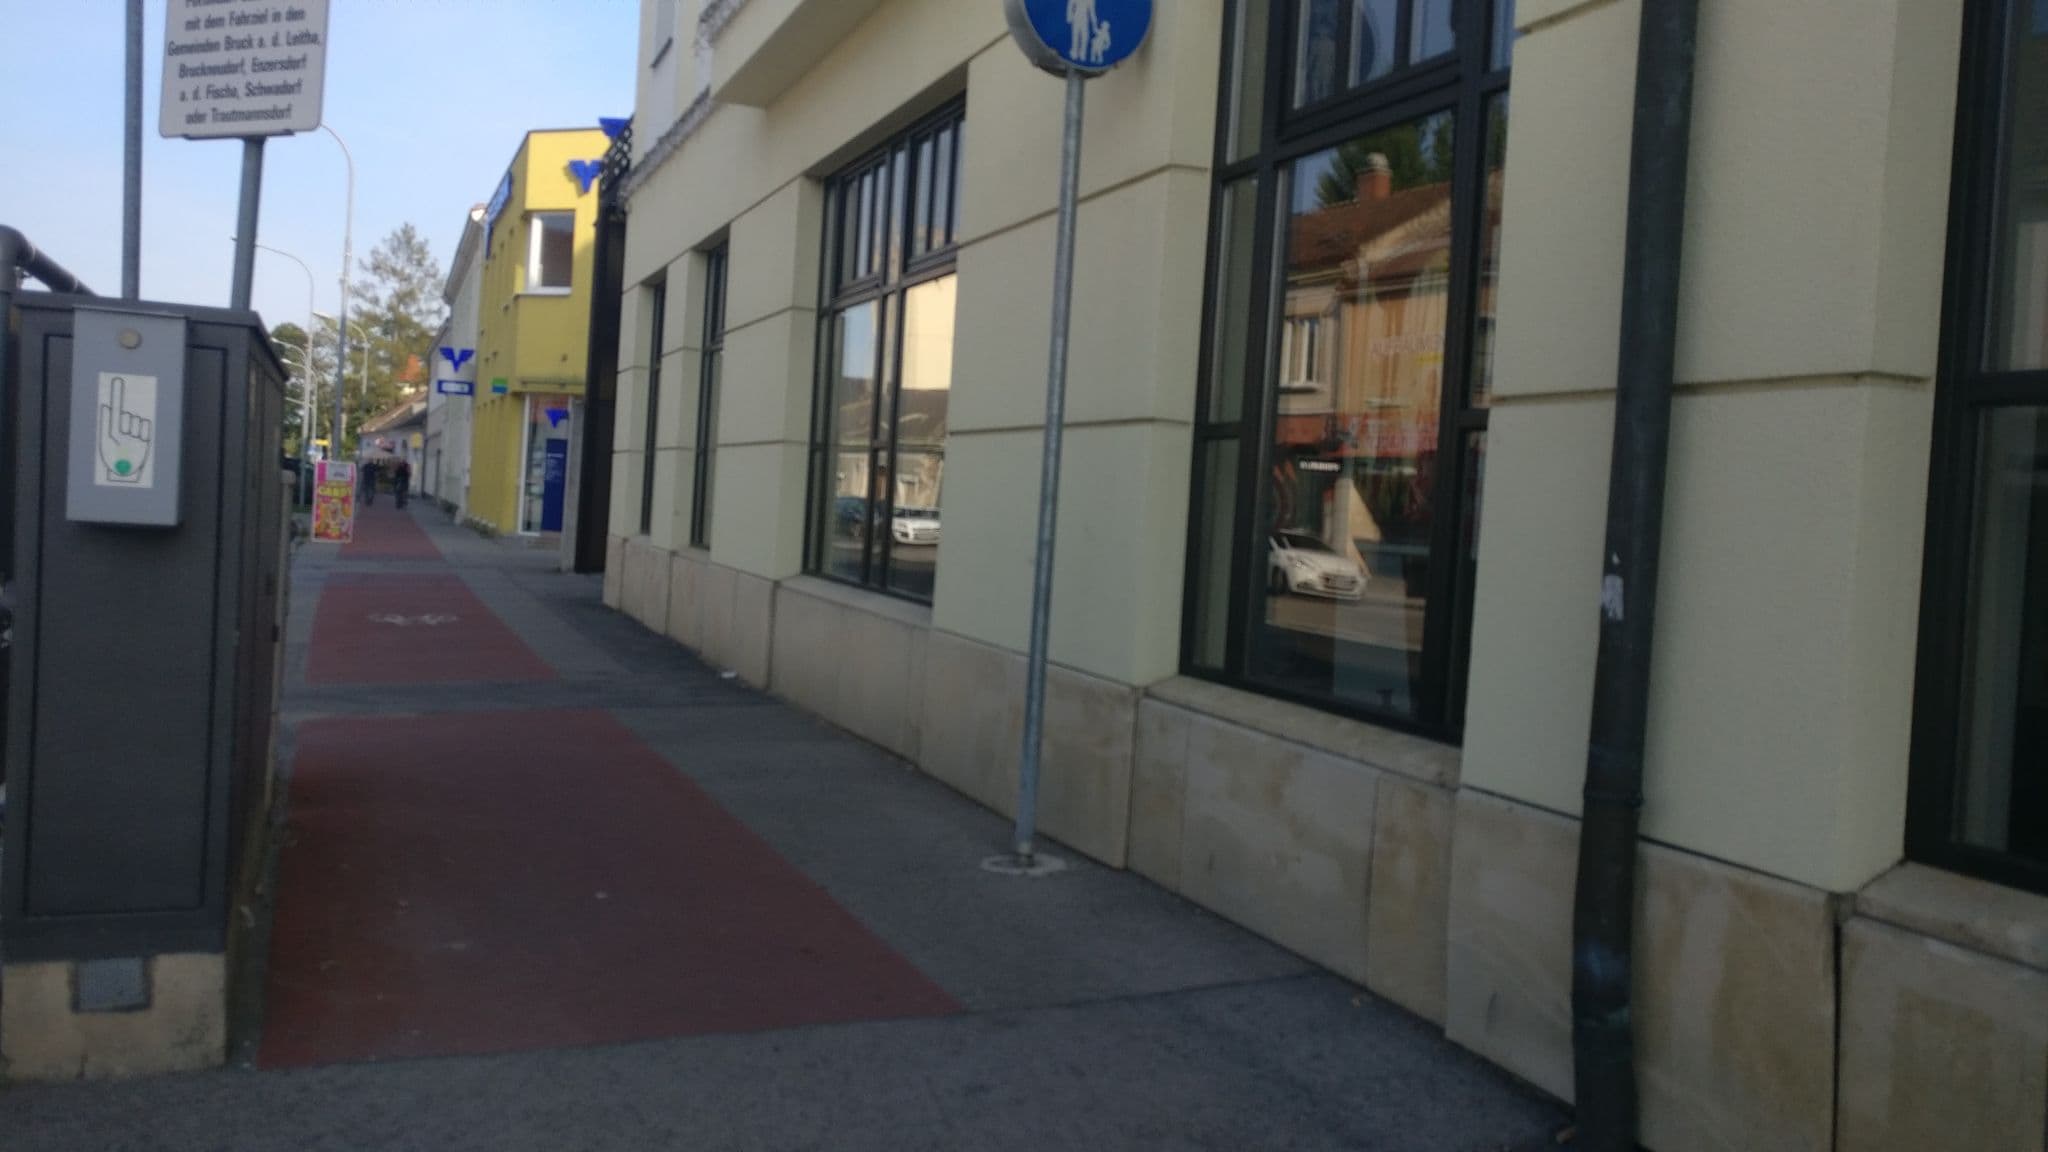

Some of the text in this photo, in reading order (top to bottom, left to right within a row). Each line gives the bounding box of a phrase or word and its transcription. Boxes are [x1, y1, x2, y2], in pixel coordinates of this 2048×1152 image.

[185, 6, 305, 31] mit dem Fahrziel in den
[168, 38, 220, 56] Gemeinden
[224, 34, 253, 51] Bruck
[257, 37, 266, 48] a.
[272, 32, 280, 47] d.
[180, 90, 188, 101] a.
[192, 86, 201, 100] d.
[186, 109, 207, 124] oder
